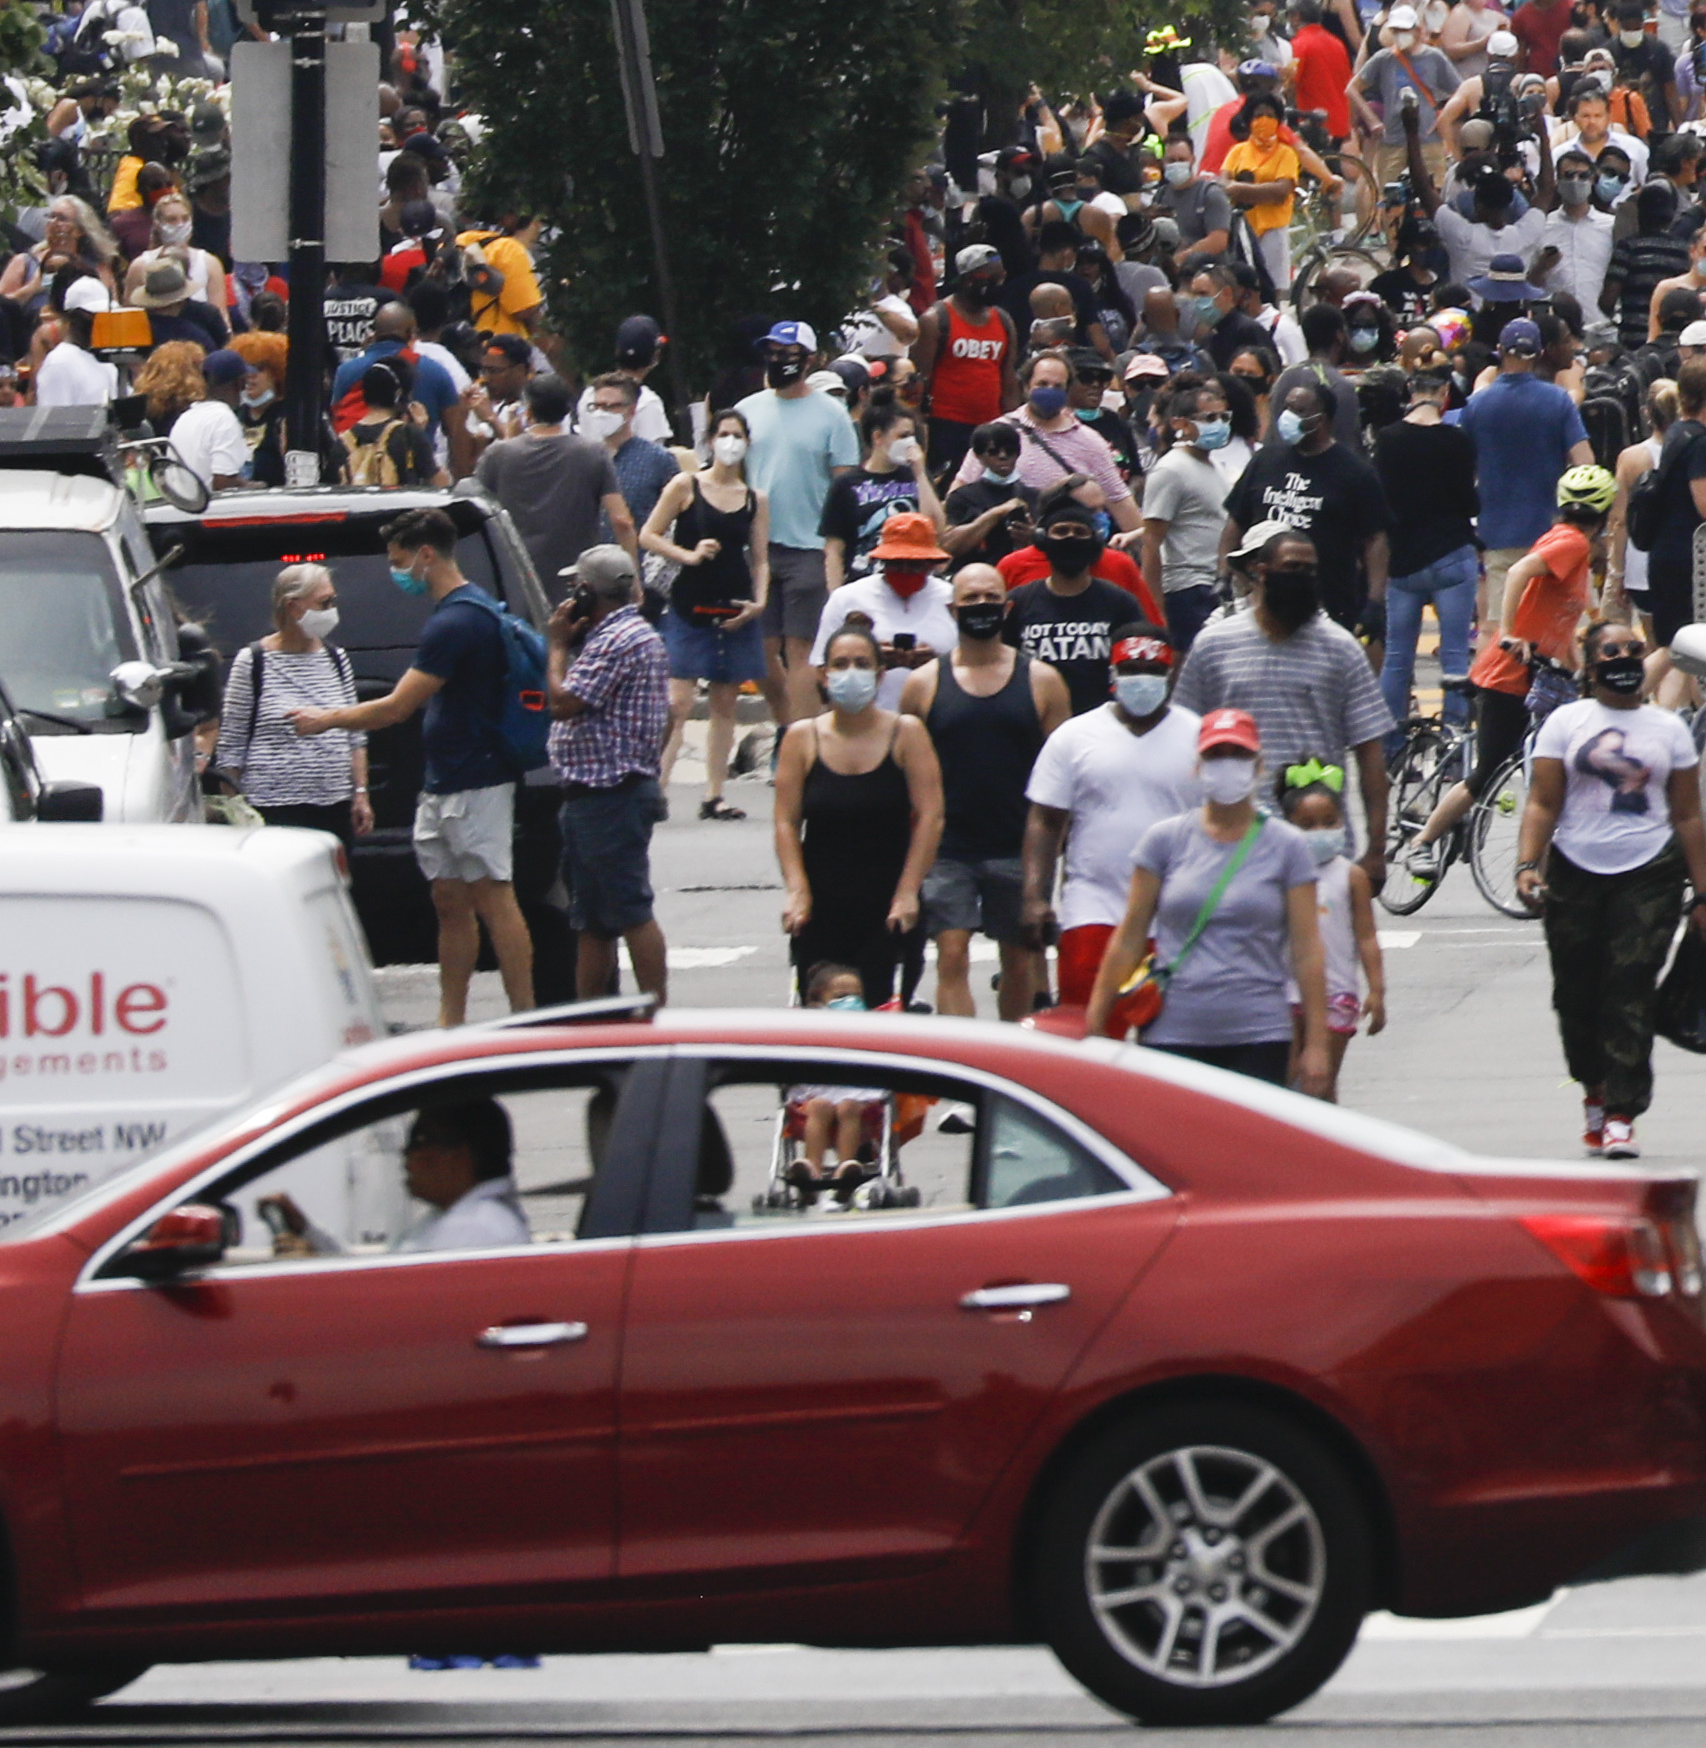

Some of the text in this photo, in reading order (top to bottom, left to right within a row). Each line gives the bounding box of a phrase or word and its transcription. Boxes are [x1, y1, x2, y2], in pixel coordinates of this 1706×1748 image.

[324, 298, 378, 318] JUSTICE
[952, 338, 1003, 360] OBEY
[1285, 472, 1311, 491] The
[1263, 486, 1324, 512] Intelligent
[1054, 621, 1111, 636] TODAY
[14, 1121, 166, 1154] Street NW
